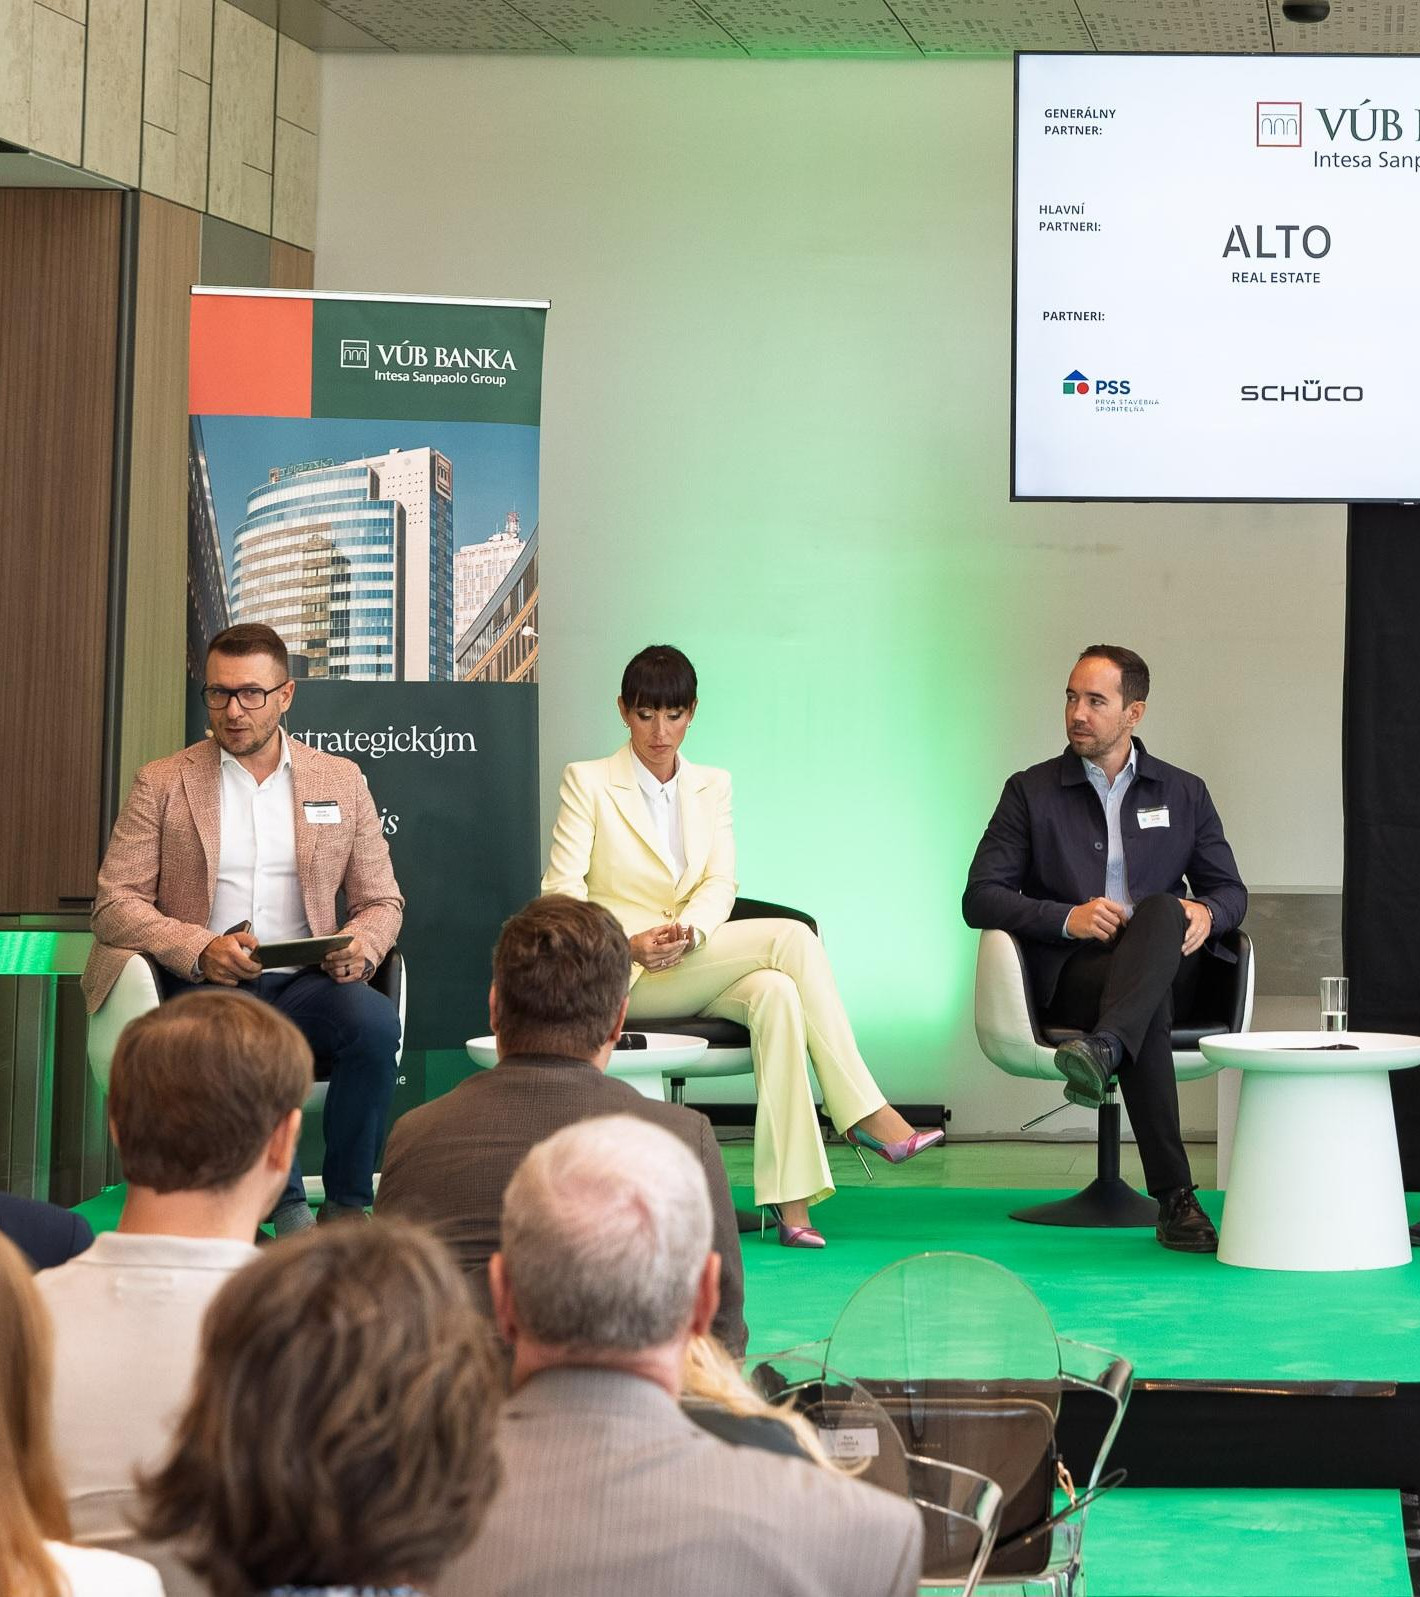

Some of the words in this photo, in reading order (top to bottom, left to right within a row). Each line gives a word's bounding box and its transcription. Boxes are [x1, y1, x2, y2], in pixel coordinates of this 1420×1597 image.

[1044, 107, 1116, 119] GENERÁLNY
[1315, 99, 1403, 143] VÚB
[1044, 126, 1103, 136] PARTNER:
[1314, 151, 1372, 169] Intesa
[1039, 202, 1085, 215] HLAVNÍ
[1039, 222, 1101, 232] PARTNERI:
[1222, 224, 1332, 259] ALTO
[1232, 272, 1266, 284] REAL
[1271, 272, 1321, 284] ESTATE
[1043, 311, 1105, 321] PARTNERI:
[376, 340, 429, 367] VÚB
[434, 346, 518, 371] BANKA
[375, 370, 410, 382] Intesa
[413, 371, 468, 385] Sanpaolo
[471, 373, 507, 387] Group
[1096, 380, 1131, 395] PSS
[1240, 379, 1364, 402] SCHÜCO
